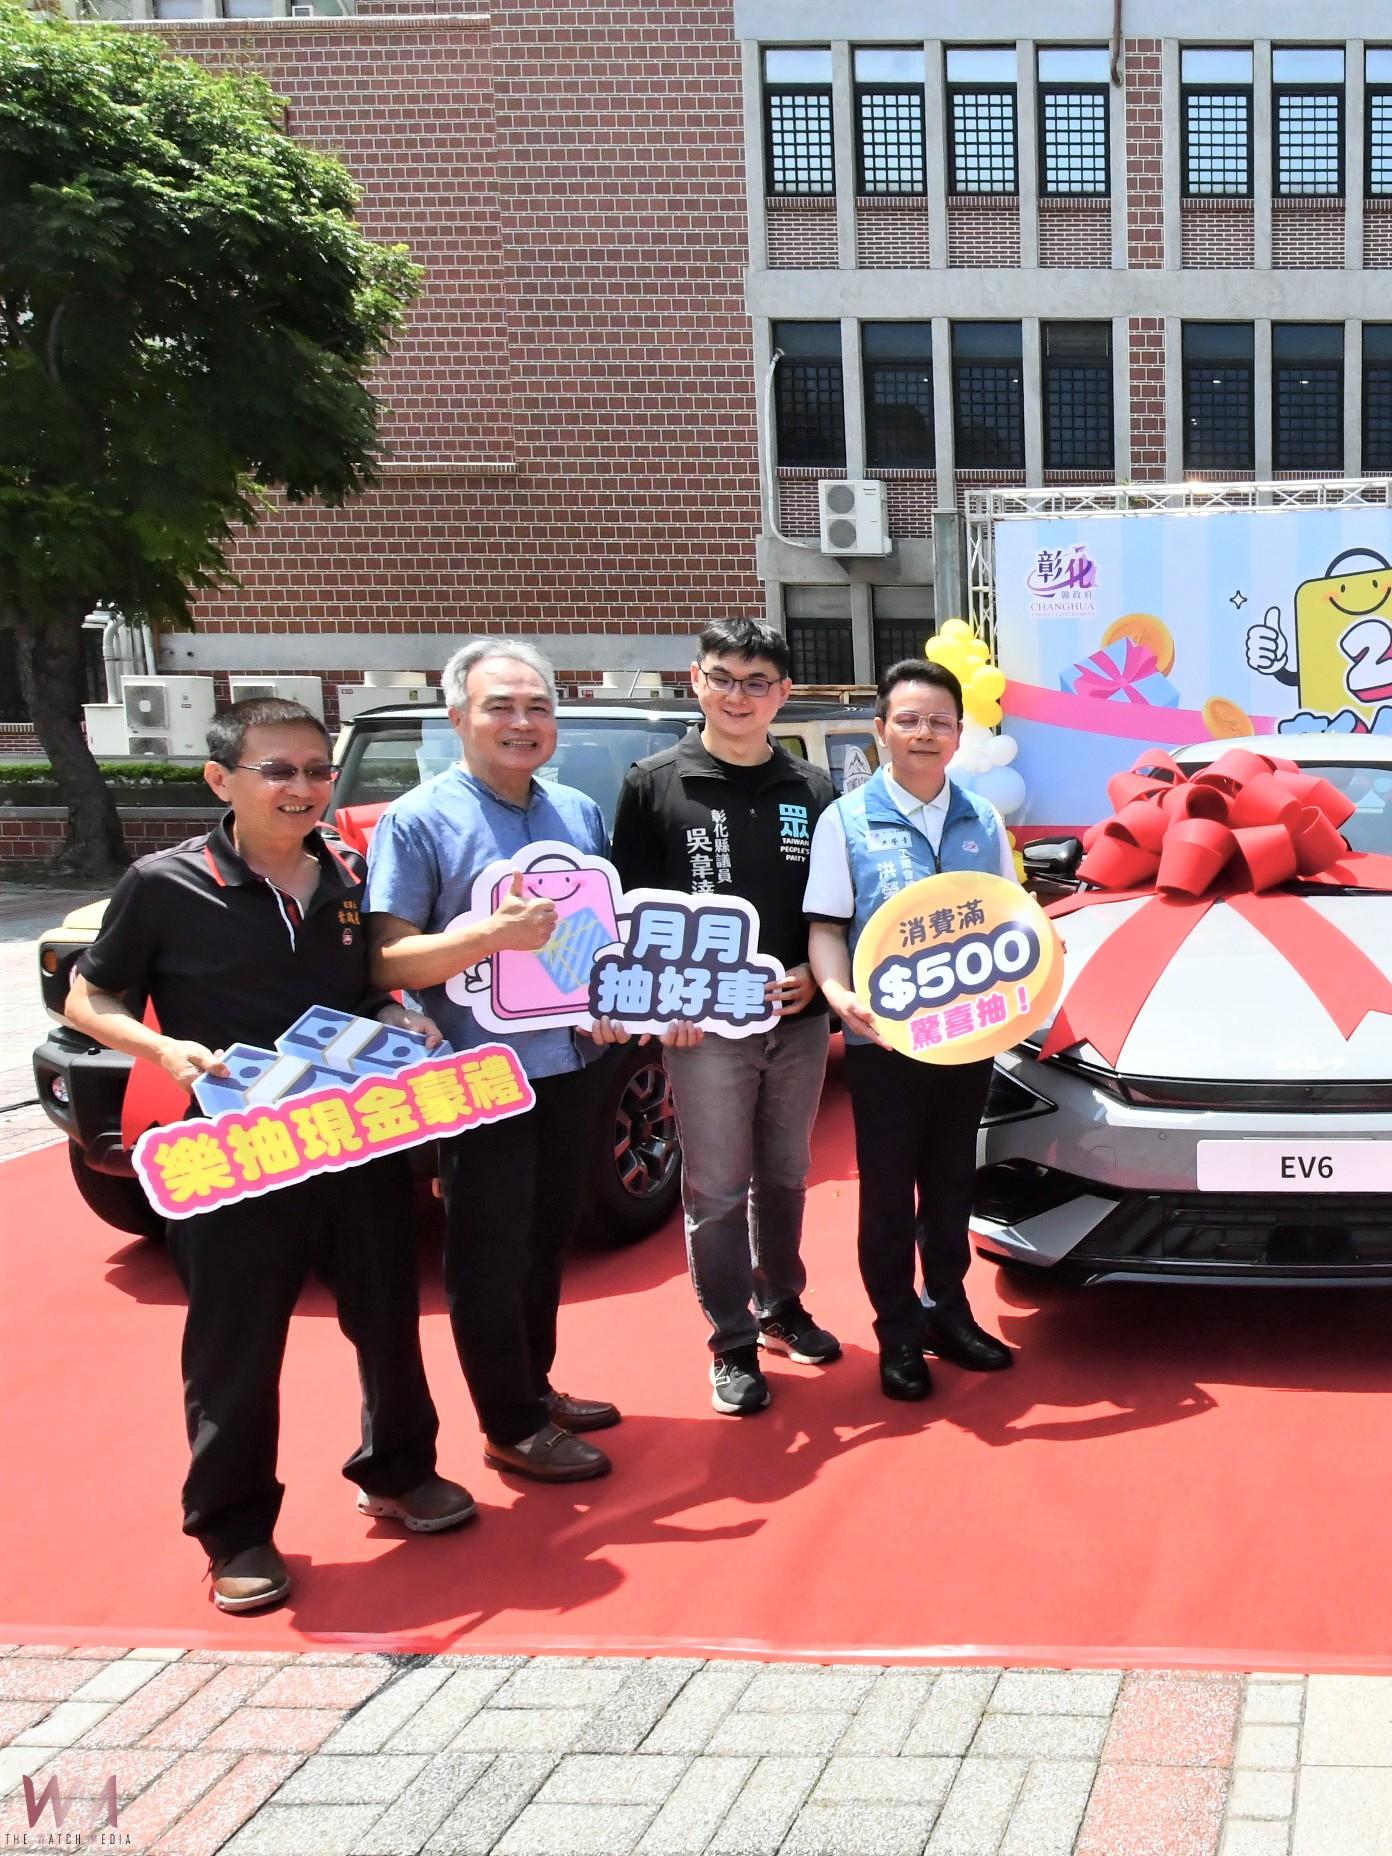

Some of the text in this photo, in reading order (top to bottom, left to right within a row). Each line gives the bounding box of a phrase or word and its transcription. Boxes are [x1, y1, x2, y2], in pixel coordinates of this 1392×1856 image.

[1030, 602, 1095, 612] CHANGHUA
[711, 809, 733, 884] 彰化縣議員
[782, 838, 809, 847] TAIWAN
[632, 909, 743, 964] 月月
[899, 898, 986, 948] 消費滿
[598, 962, 769, 1020] 抽好車
[878, 930, 1031, 1012] $500
[153, 1054, 524, 1203] 樂抽現金豪禮
[1280, 1155, 1334, 1179] EV6
